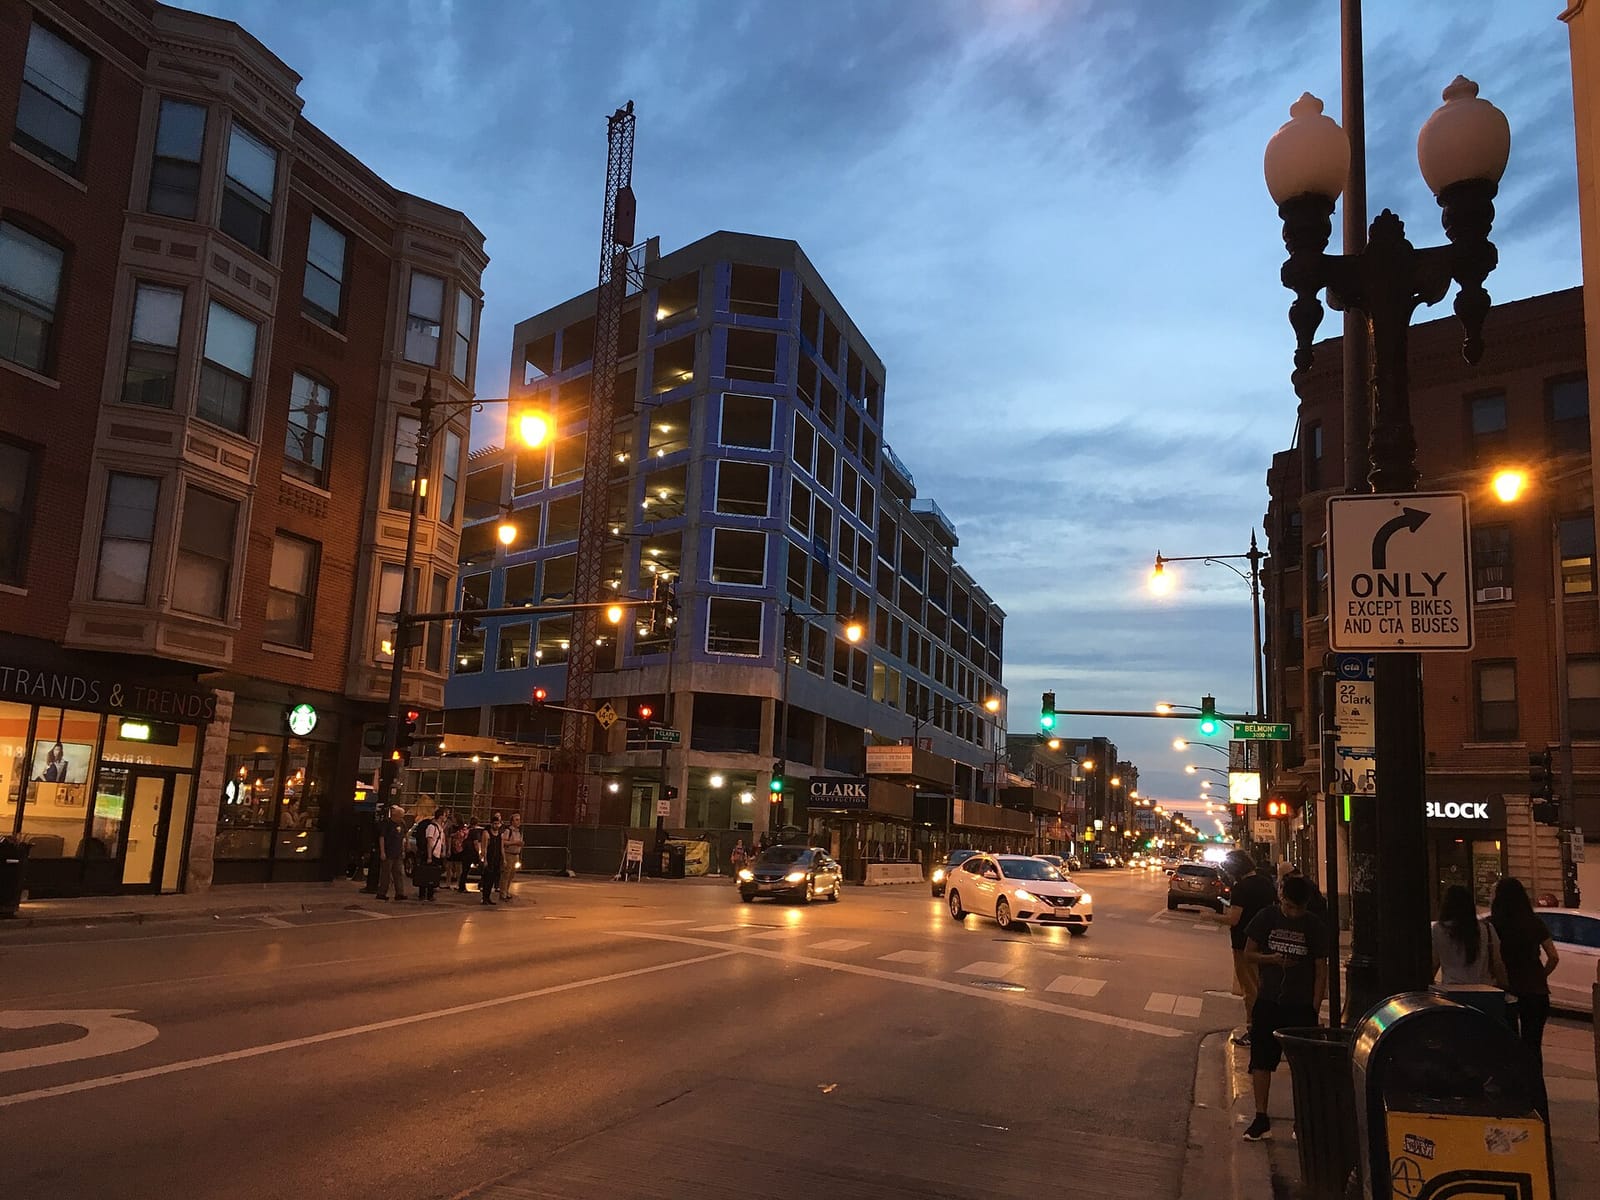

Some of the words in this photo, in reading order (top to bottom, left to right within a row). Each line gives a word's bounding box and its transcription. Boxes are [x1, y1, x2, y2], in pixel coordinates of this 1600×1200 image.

[1351, 572, 1448, 598] ONLY
[1348, 601, 1402, 616] EXCEPT
[1411, 600, 1453, 615] BIKES
[1344, 618, 1372, 634] AND
[1379, 618, 1404, 633] CTA
[1411, 617, 1460, 633] BUSES
[1340, 684, 1356, 695] 22
[109, 683, 125, 708] &
[134, 686, 215, 719] TRENDS
[1340, 694, 1372, 705] Clark
[1244, 725, 1276, 733] BELMONT
[810, 782, 867, 797] CLARK
[810, 796, 866, 804] CONSTRUCTION
[1426, 802, 1489, 819] BLOCK
